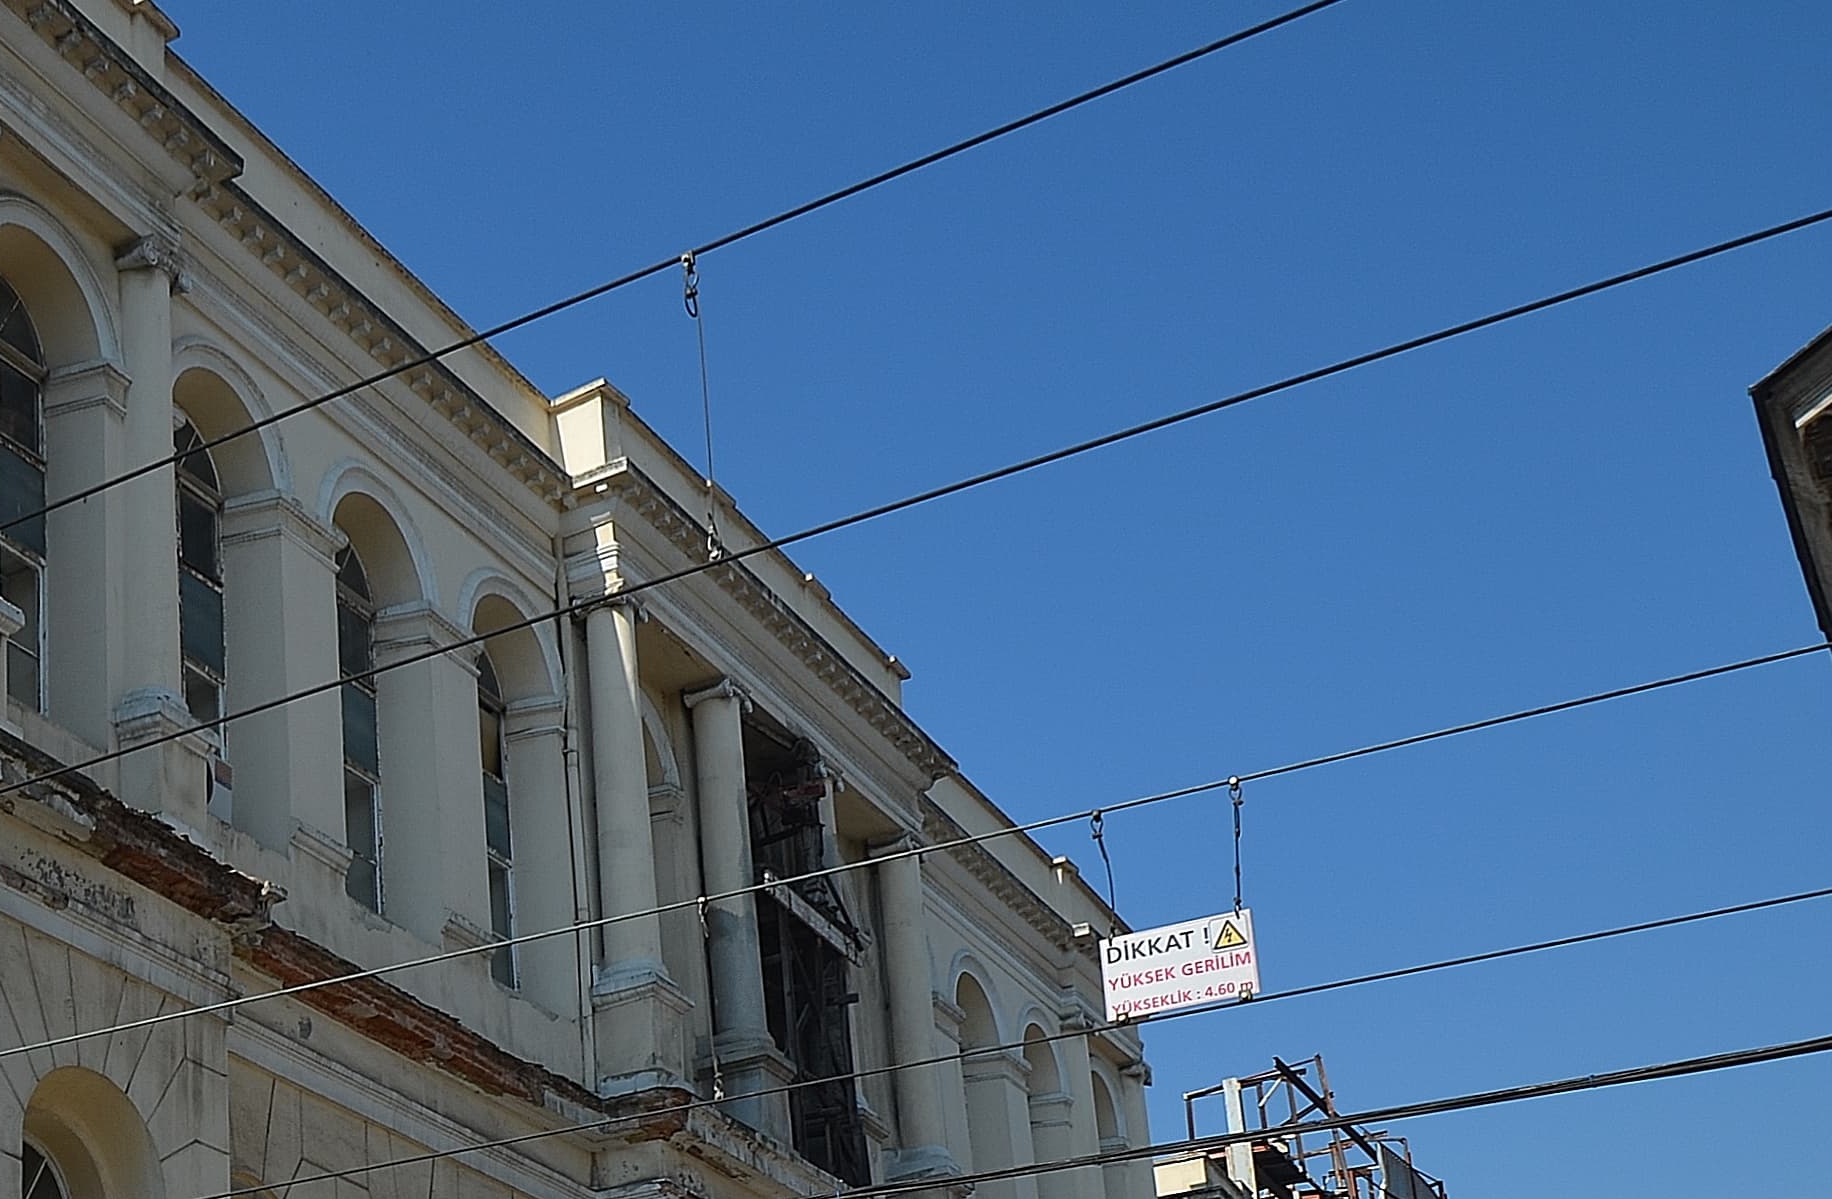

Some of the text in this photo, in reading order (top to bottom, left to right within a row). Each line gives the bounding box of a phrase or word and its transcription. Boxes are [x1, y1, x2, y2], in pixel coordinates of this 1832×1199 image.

[1107, 930, 1194, 964] DİKKAT
[1108, 951, 1252, 991] YÜKSEK GERİLİM
[1111, 989, 1193, 1015] YÜKSEKLİK
[1204, 982, 1235, 998] 4.60
